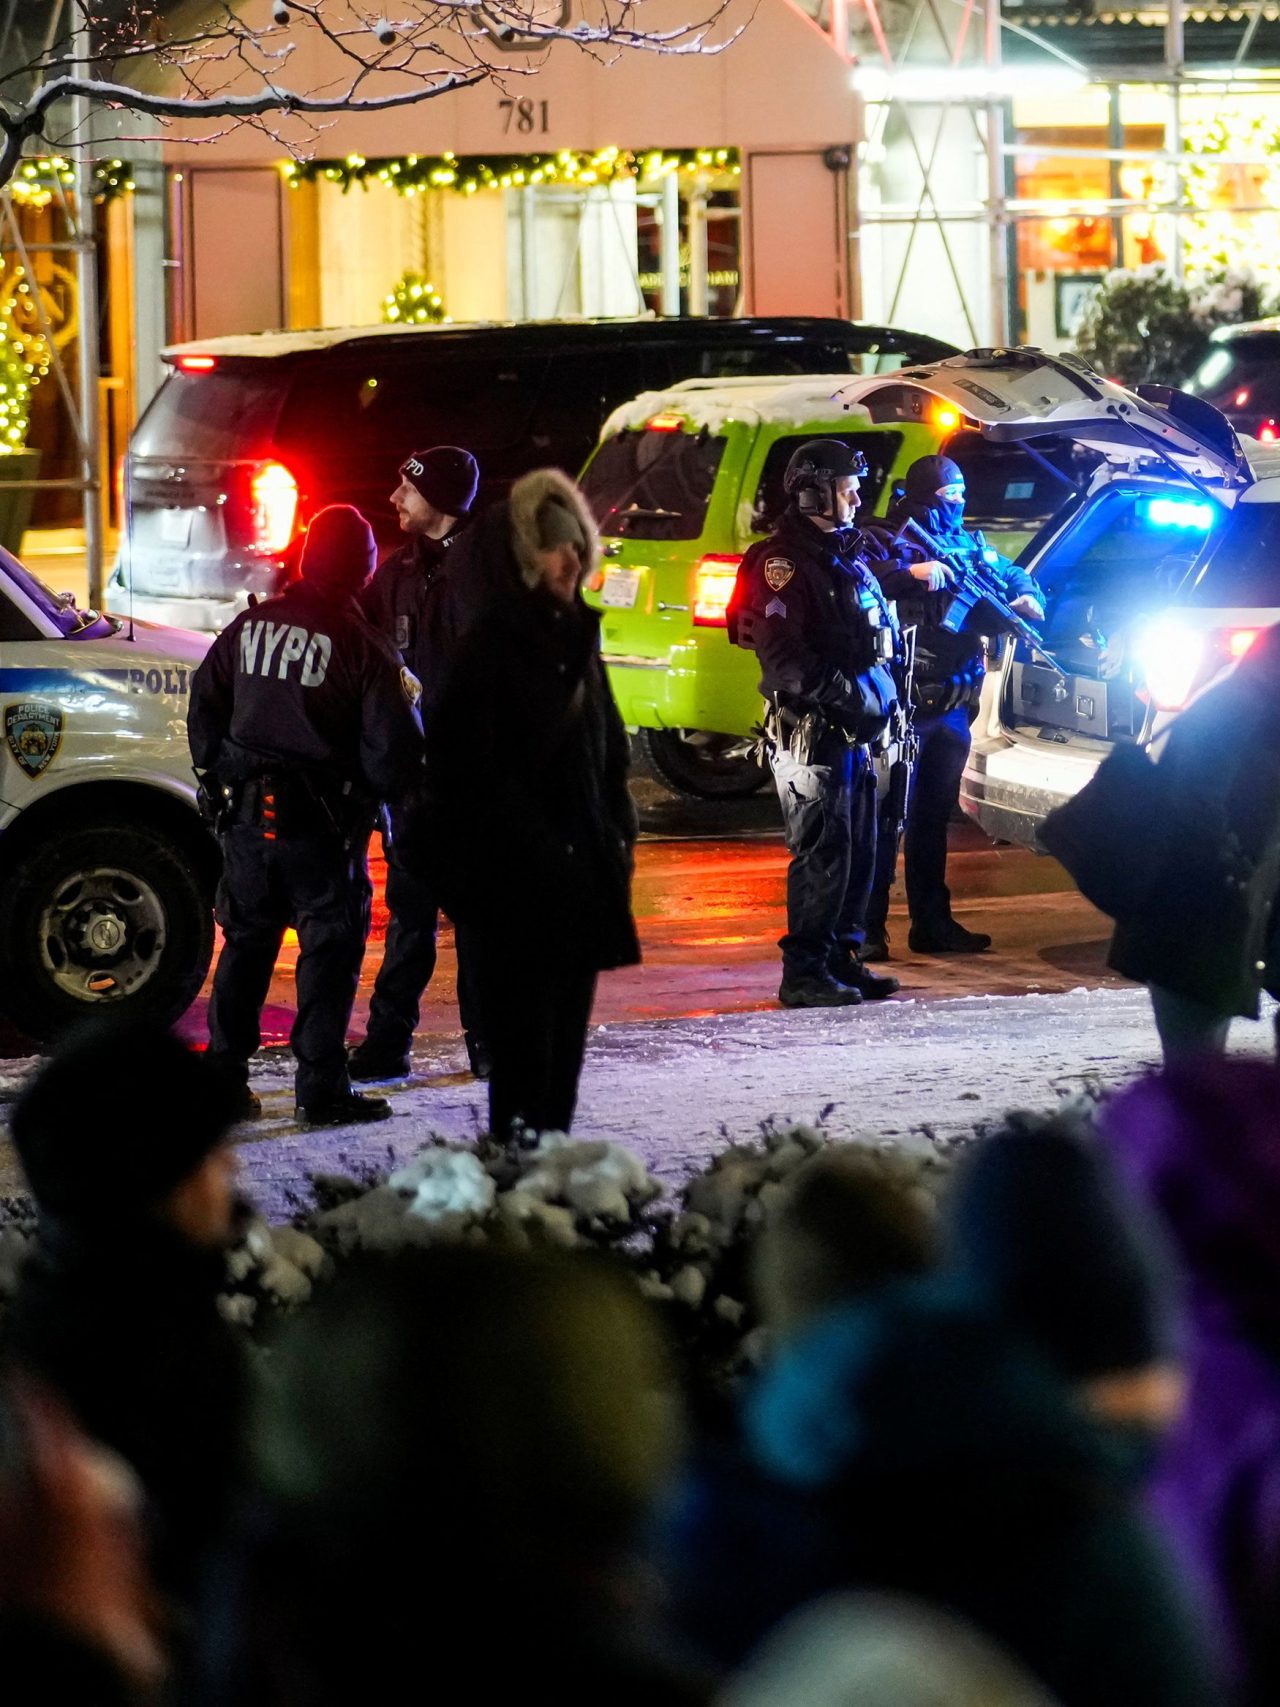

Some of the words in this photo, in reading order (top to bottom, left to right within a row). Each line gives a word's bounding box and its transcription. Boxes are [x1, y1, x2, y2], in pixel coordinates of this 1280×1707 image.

[498, 99, 549, 134] 781
[240, 619, 332, 687] NYPD
[130, 668, 197, 695] POLI
[7, 713, 60, 726] DEPARTMENT
[18, 704, 49, 713] POLICE
